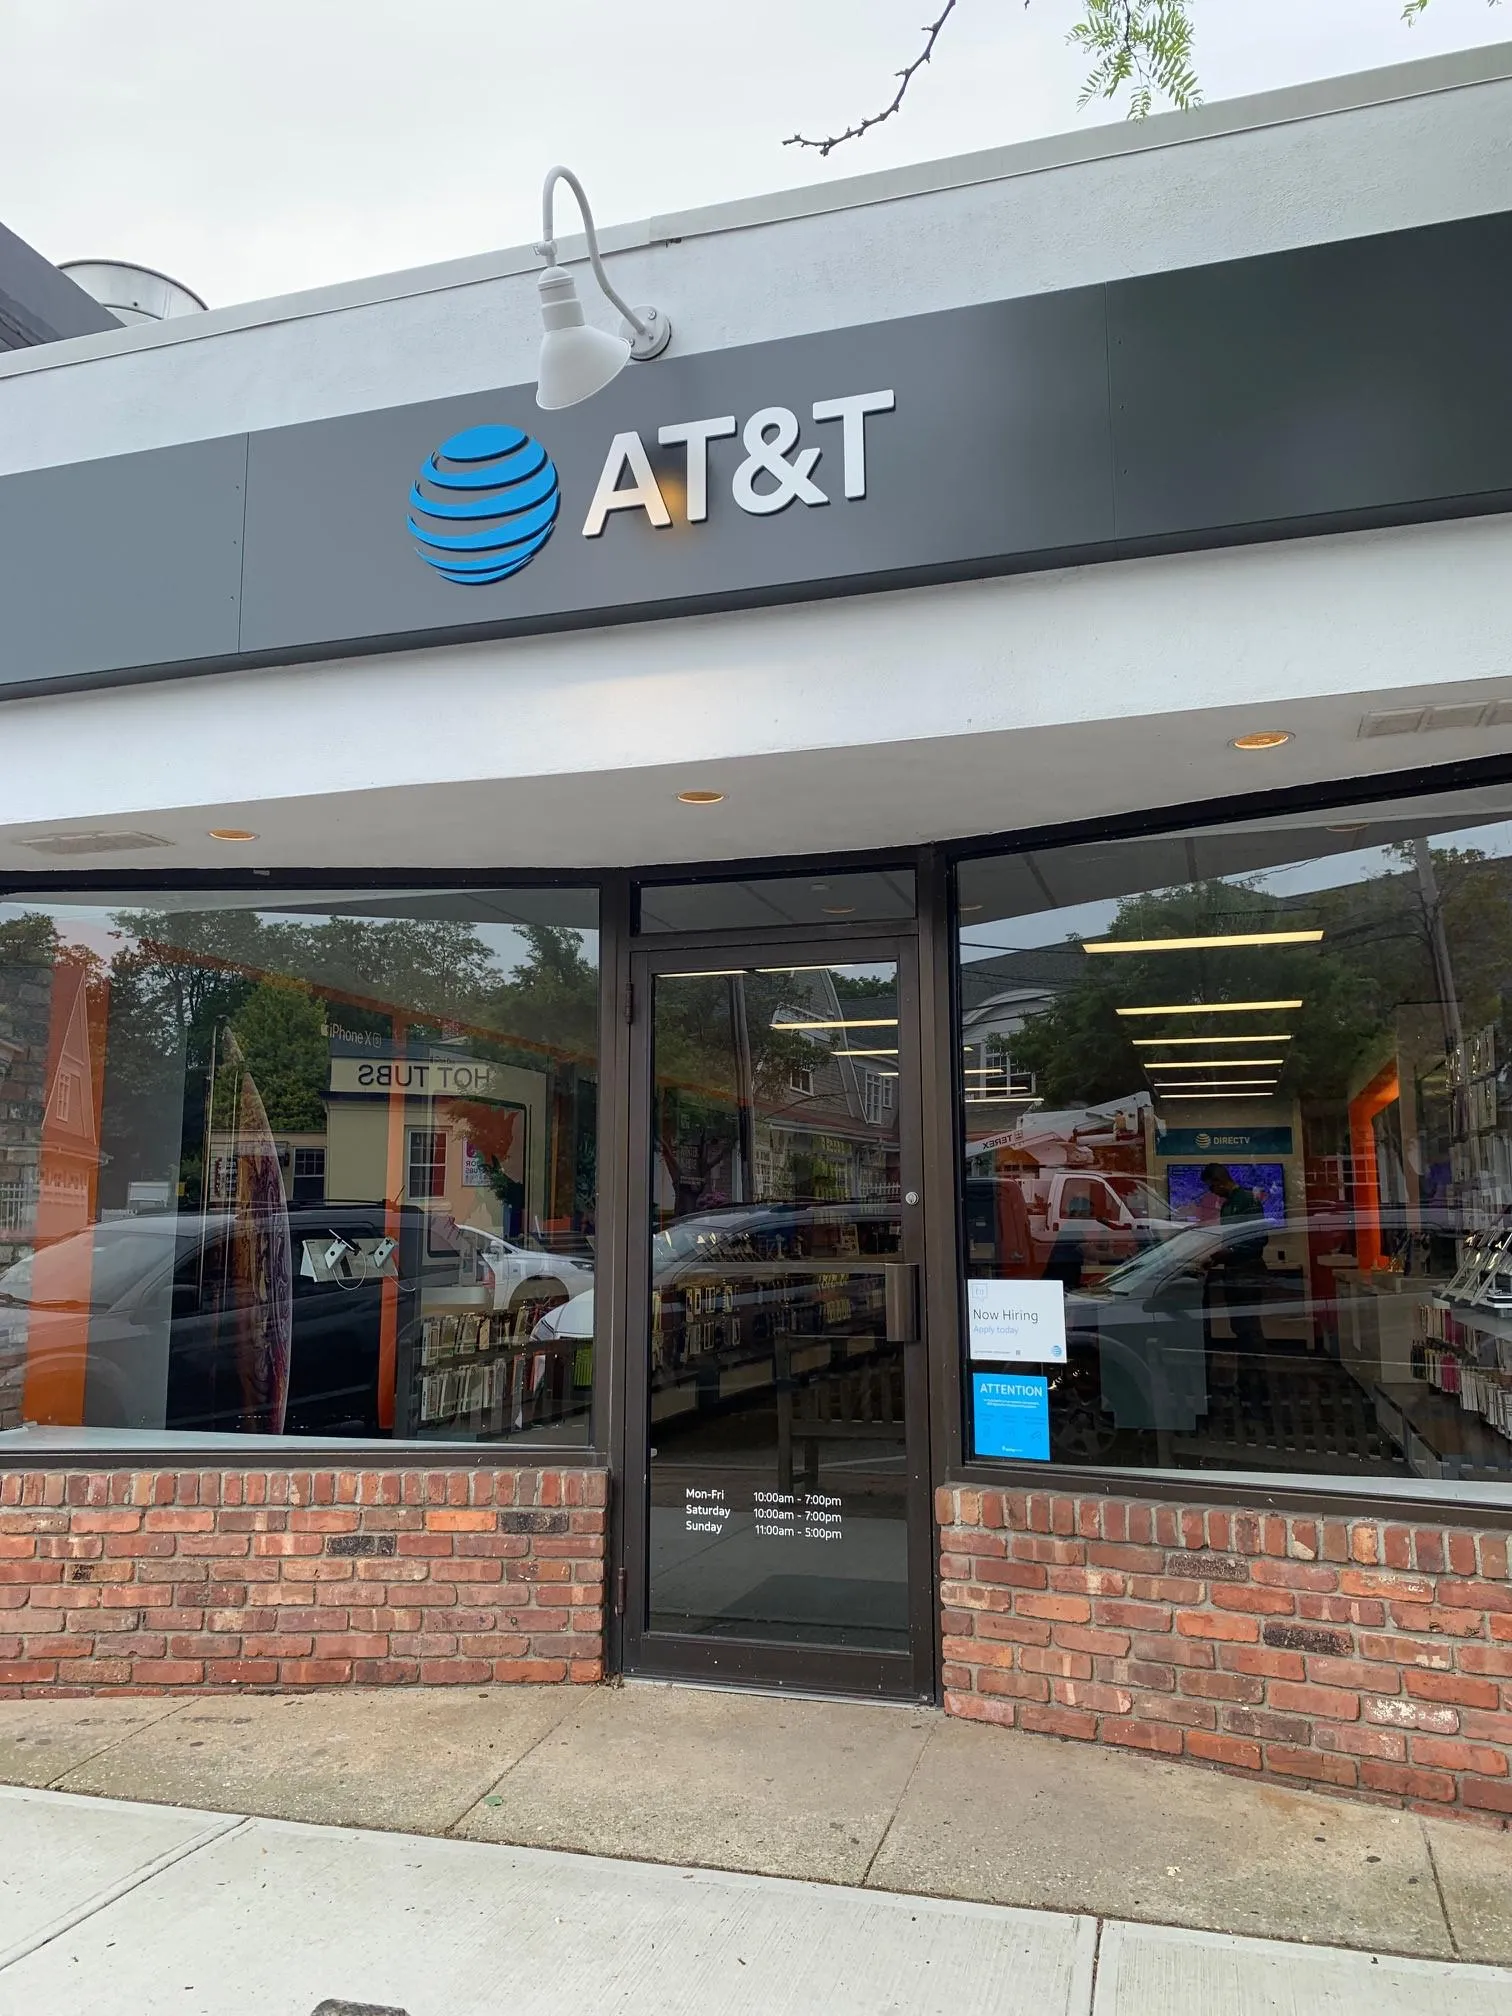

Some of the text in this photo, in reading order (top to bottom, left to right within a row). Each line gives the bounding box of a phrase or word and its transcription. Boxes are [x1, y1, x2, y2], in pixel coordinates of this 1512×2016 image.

[582, 389, 895, 538] AT&T
[329, 1023, 364, 1044] iPhone
[1213, 1136, 1250, 1145] DIRECTV
[973, 1309, 1038, 1325] Now Hiring
[973, 1325, 1019, 1336] Apply today
[980, 1383, 1043, 1397] ATTENTION
[685, 1488, 724, 1500] Mon-Fri
[753, 1492, 794, 1504] 10:00am
[804, 1494, 842, 1507] 7:00pm
[685, 1504, 731, 1518] Saturday
[753, 1508, 794, 1520] 10:00am
[804, 1511, 842, 1524] 7:00pm
[685, 1520, 723, 1535] Sunday
[755, 1525, 794, 1537] 11:00am
[804, 1527, 842, 1541] 5:00pm
